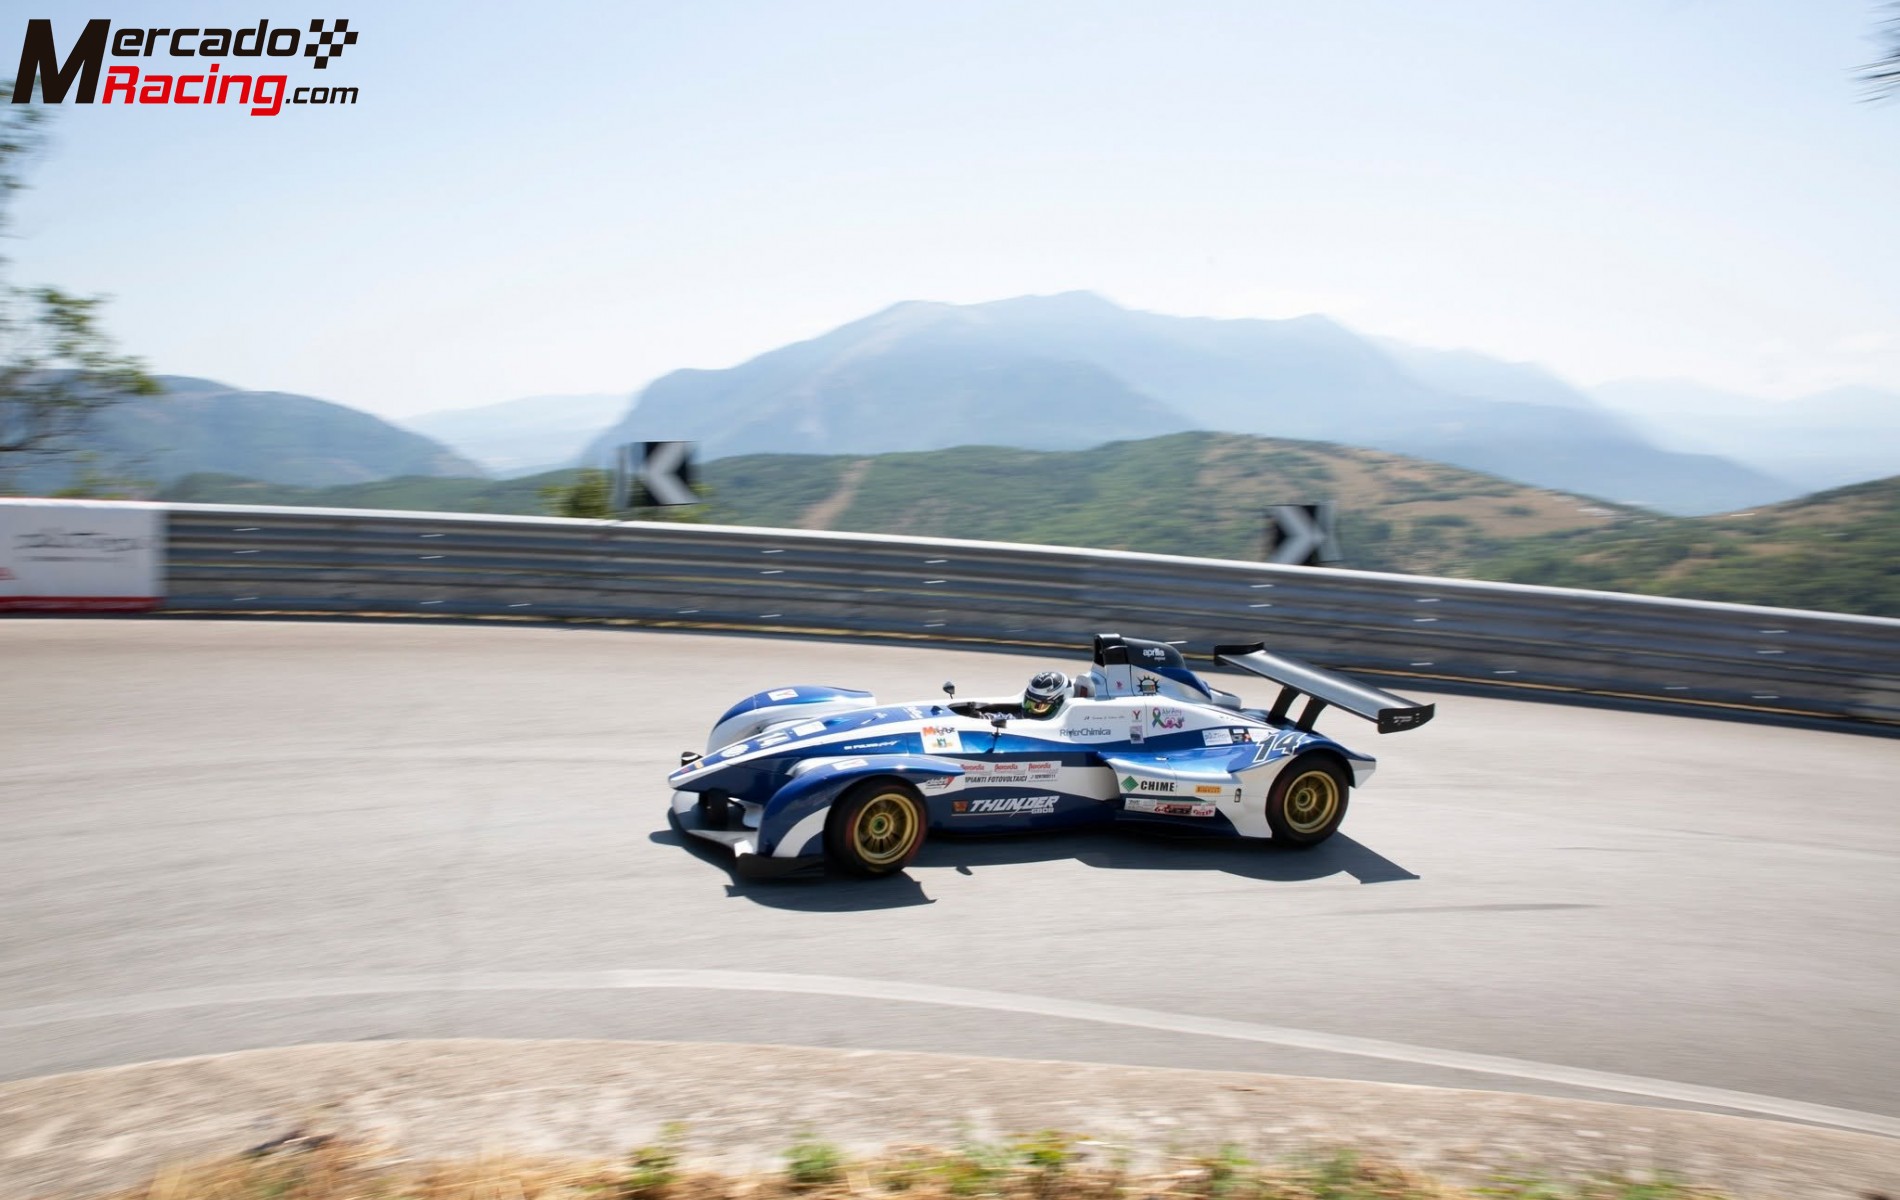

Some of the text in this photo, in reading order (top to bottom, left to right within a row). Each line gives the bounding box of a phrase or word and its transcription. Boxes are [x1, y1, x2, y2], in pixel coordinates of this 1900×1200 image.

[1252, 732, 1308, 763] 14
[1140, 780, 1175, 792] CHIME
[970, 795, 1060, 815] THUNDER
